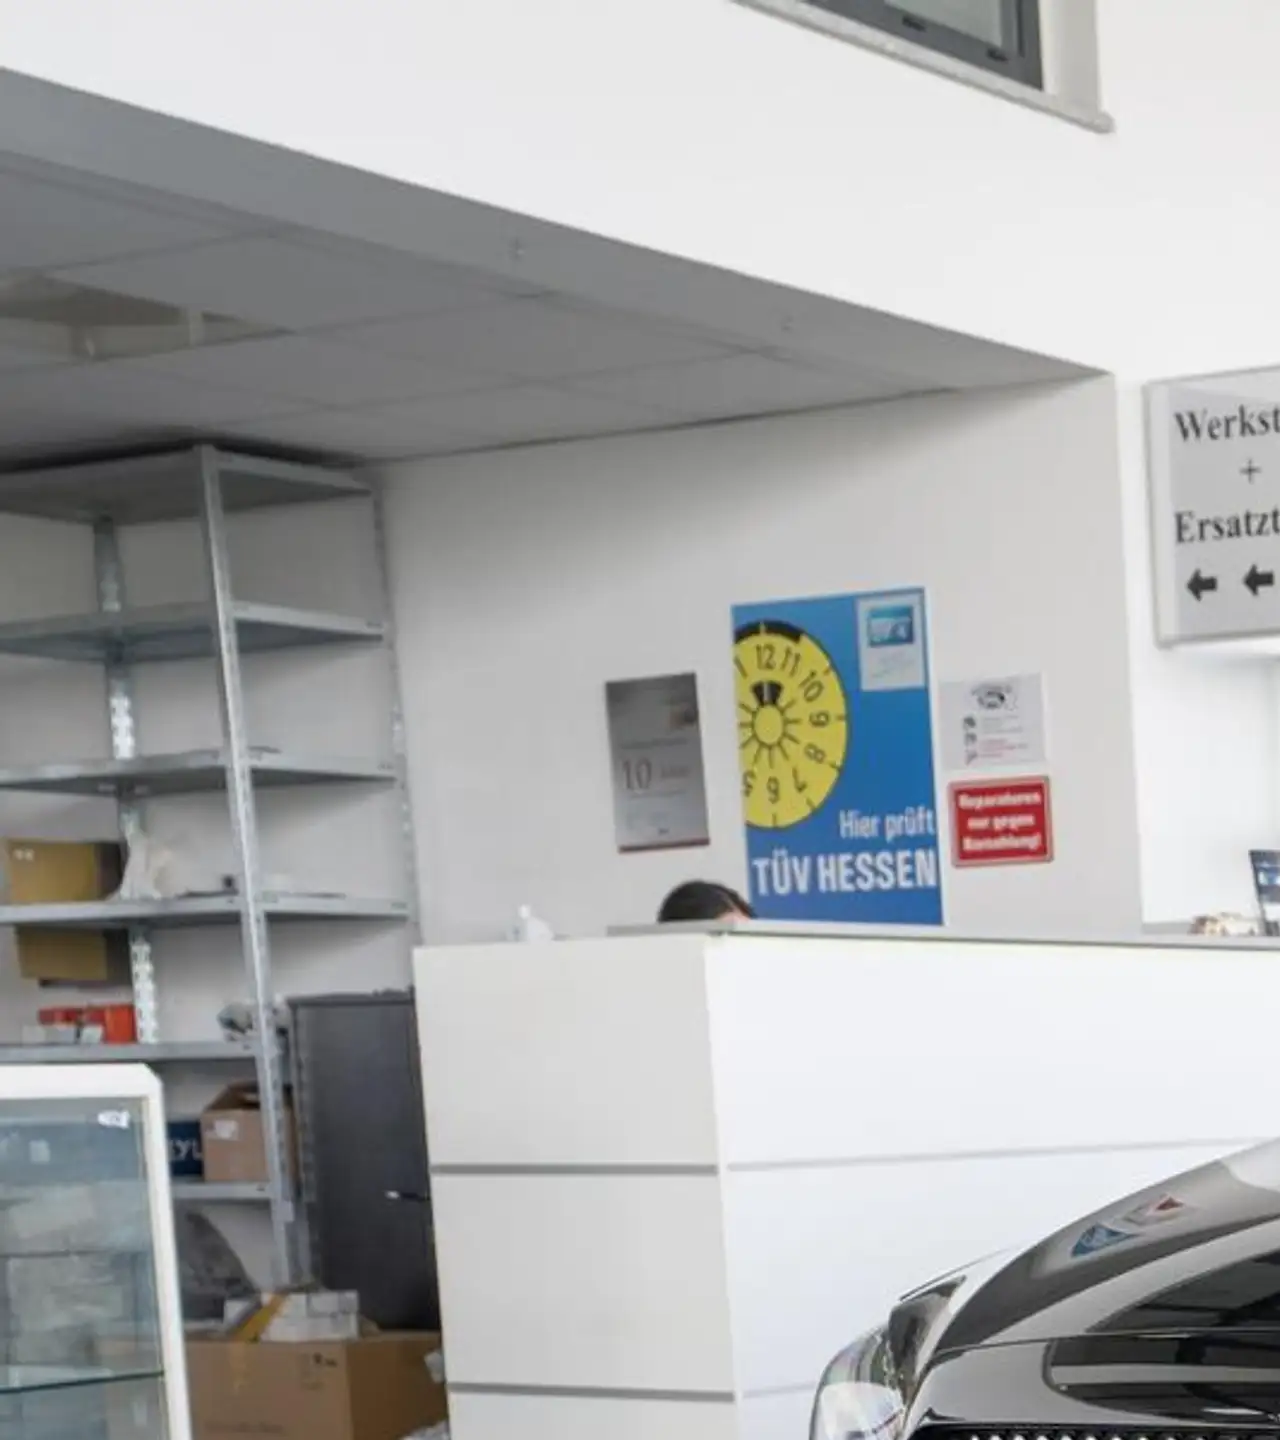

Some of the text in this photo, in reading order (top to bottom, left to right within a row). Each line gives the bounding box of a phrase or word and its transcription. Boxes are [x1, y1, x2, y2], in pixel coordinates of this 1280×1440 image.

[1239, 458, 1261, 484] +
[755, 643, 776, 670] 12
[798, 670, 824, 702] 10
[623, 757, 652, 790] 10
[839, 806, 936, 843] Hier prüft
[753, 847, 938, 896] TÜV HESSEN
